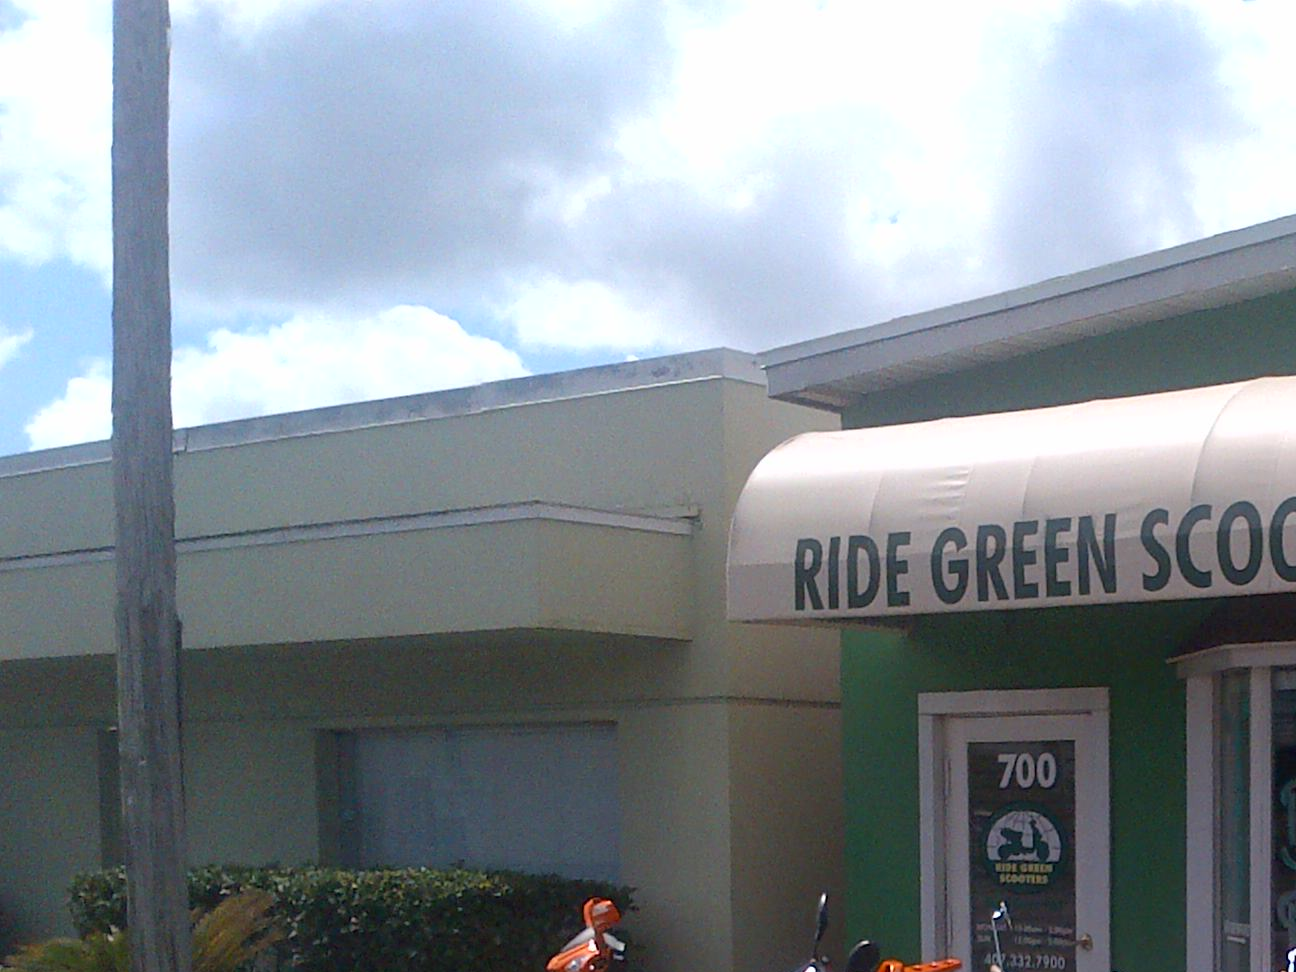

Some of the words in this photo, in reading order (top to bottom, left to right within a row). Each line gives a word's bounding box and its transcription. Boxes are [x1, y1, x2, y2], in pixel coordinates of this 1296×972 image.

[794, 531, 911, 611] RIDE
[930, 513, 1117, 605] GREEN
[997, 752, 1057, 789] 700
[995, 863, 1017, 873] RIDE
[1020, 863, 1053, 873] GREEN
[1000, 874, 1048, 885] SCOOTERS
